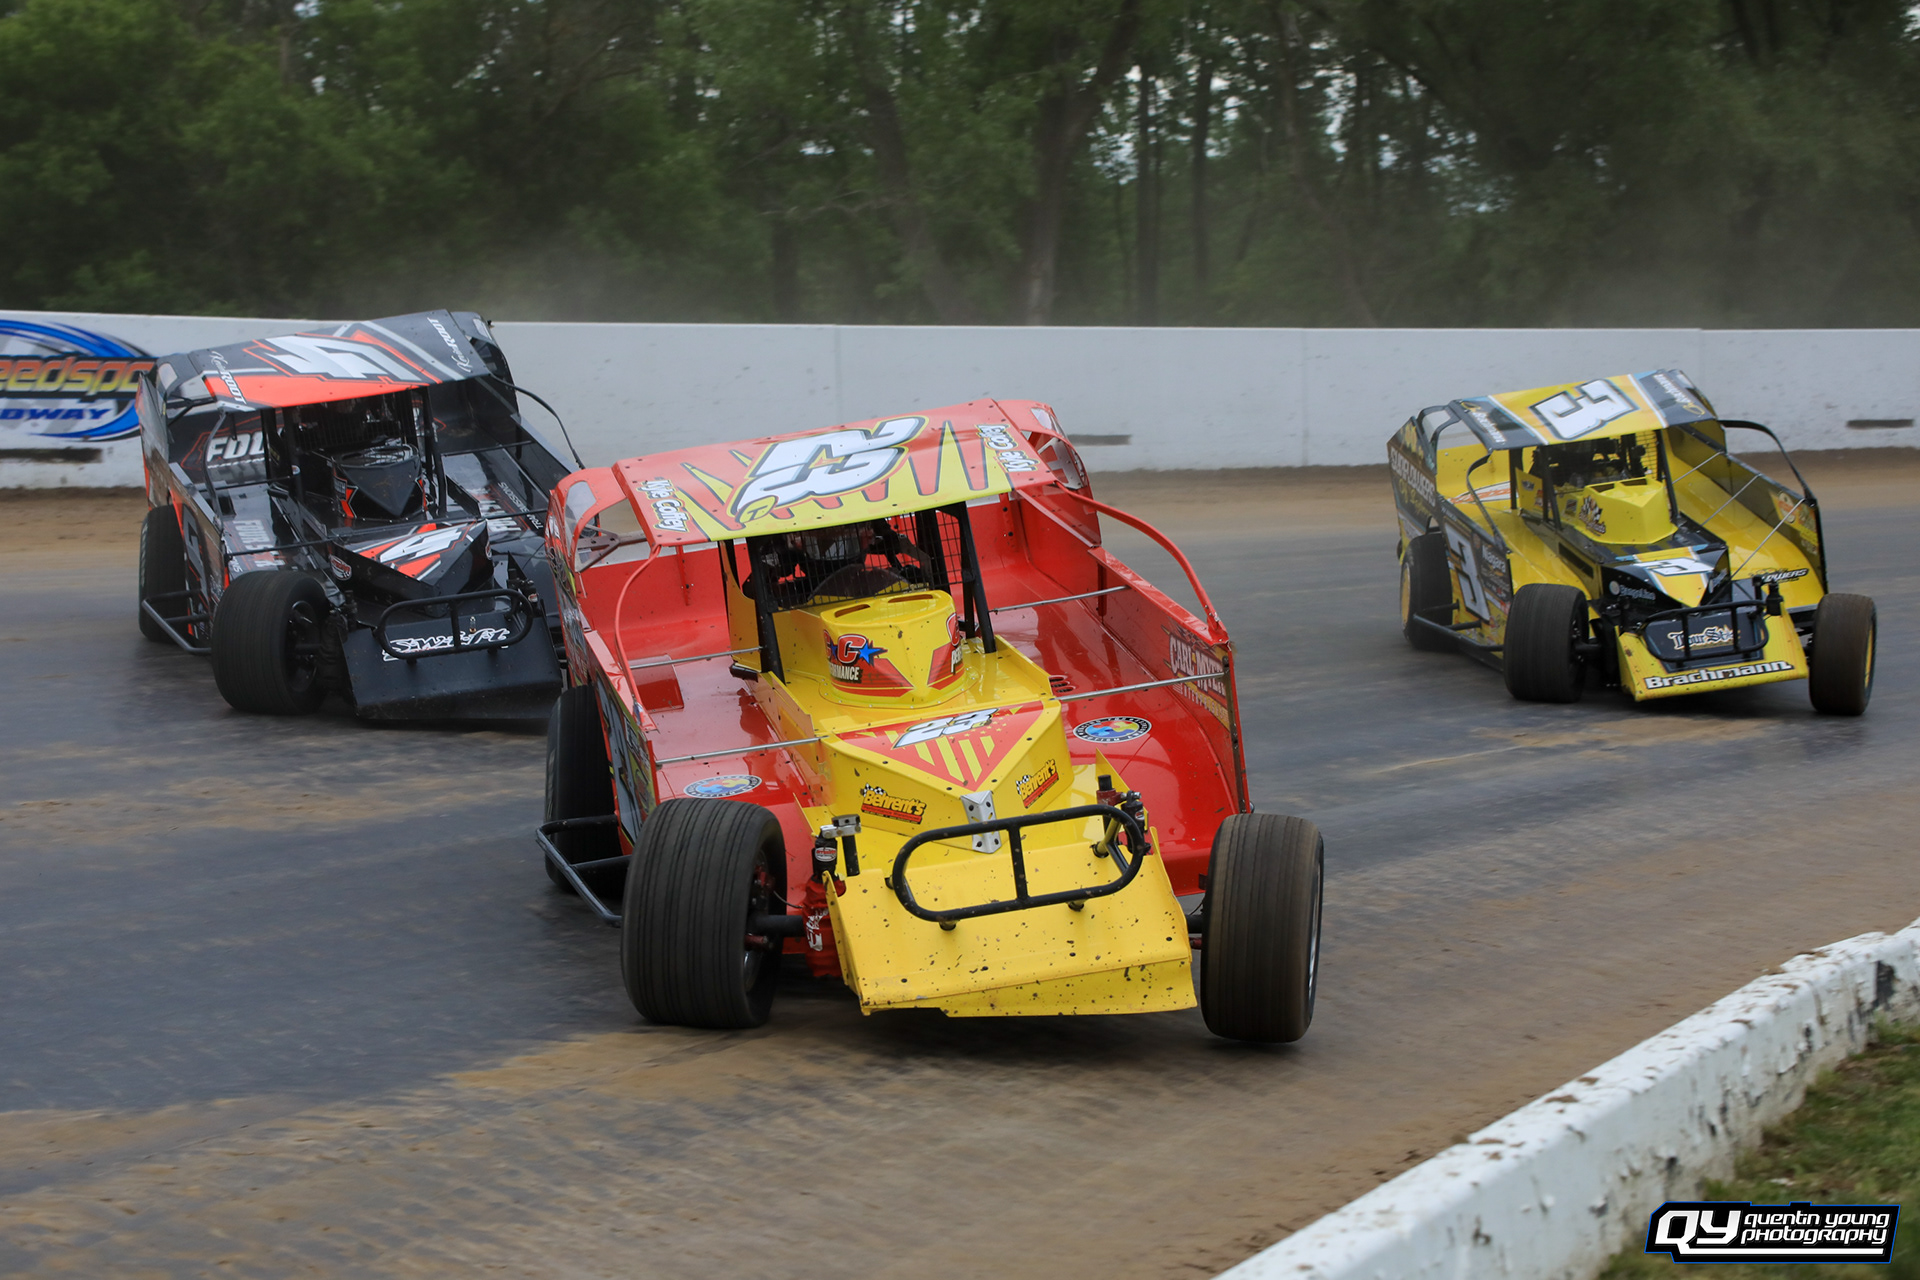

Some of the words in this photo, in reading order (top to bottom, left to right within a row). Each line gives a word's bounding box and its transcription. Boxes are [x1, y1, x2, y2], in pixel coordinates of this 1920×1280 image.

[426, 317, 456, 347] ROOT
[220, 371, 247, 404] ROOT
[1533, 378, 1636, 440] 3
[976, 424, 1017, 450] Coffey
[735, 417, 924, 512] 23
[998, 450, 1038, 472] Kyle
[637, 479, 675, 499] Kyle
[653, 499, 688, 532] Coffey
[1444, 521, 1491, 624] 3
[1634, 557, 1715, 576] 3
[1645, 660, 1794, 690] Brachmann
[893, 708, 999, 749] 23
[1020, 759, 1057, 801] Behrent's
[863, 789, 927, 816] Behrent's
